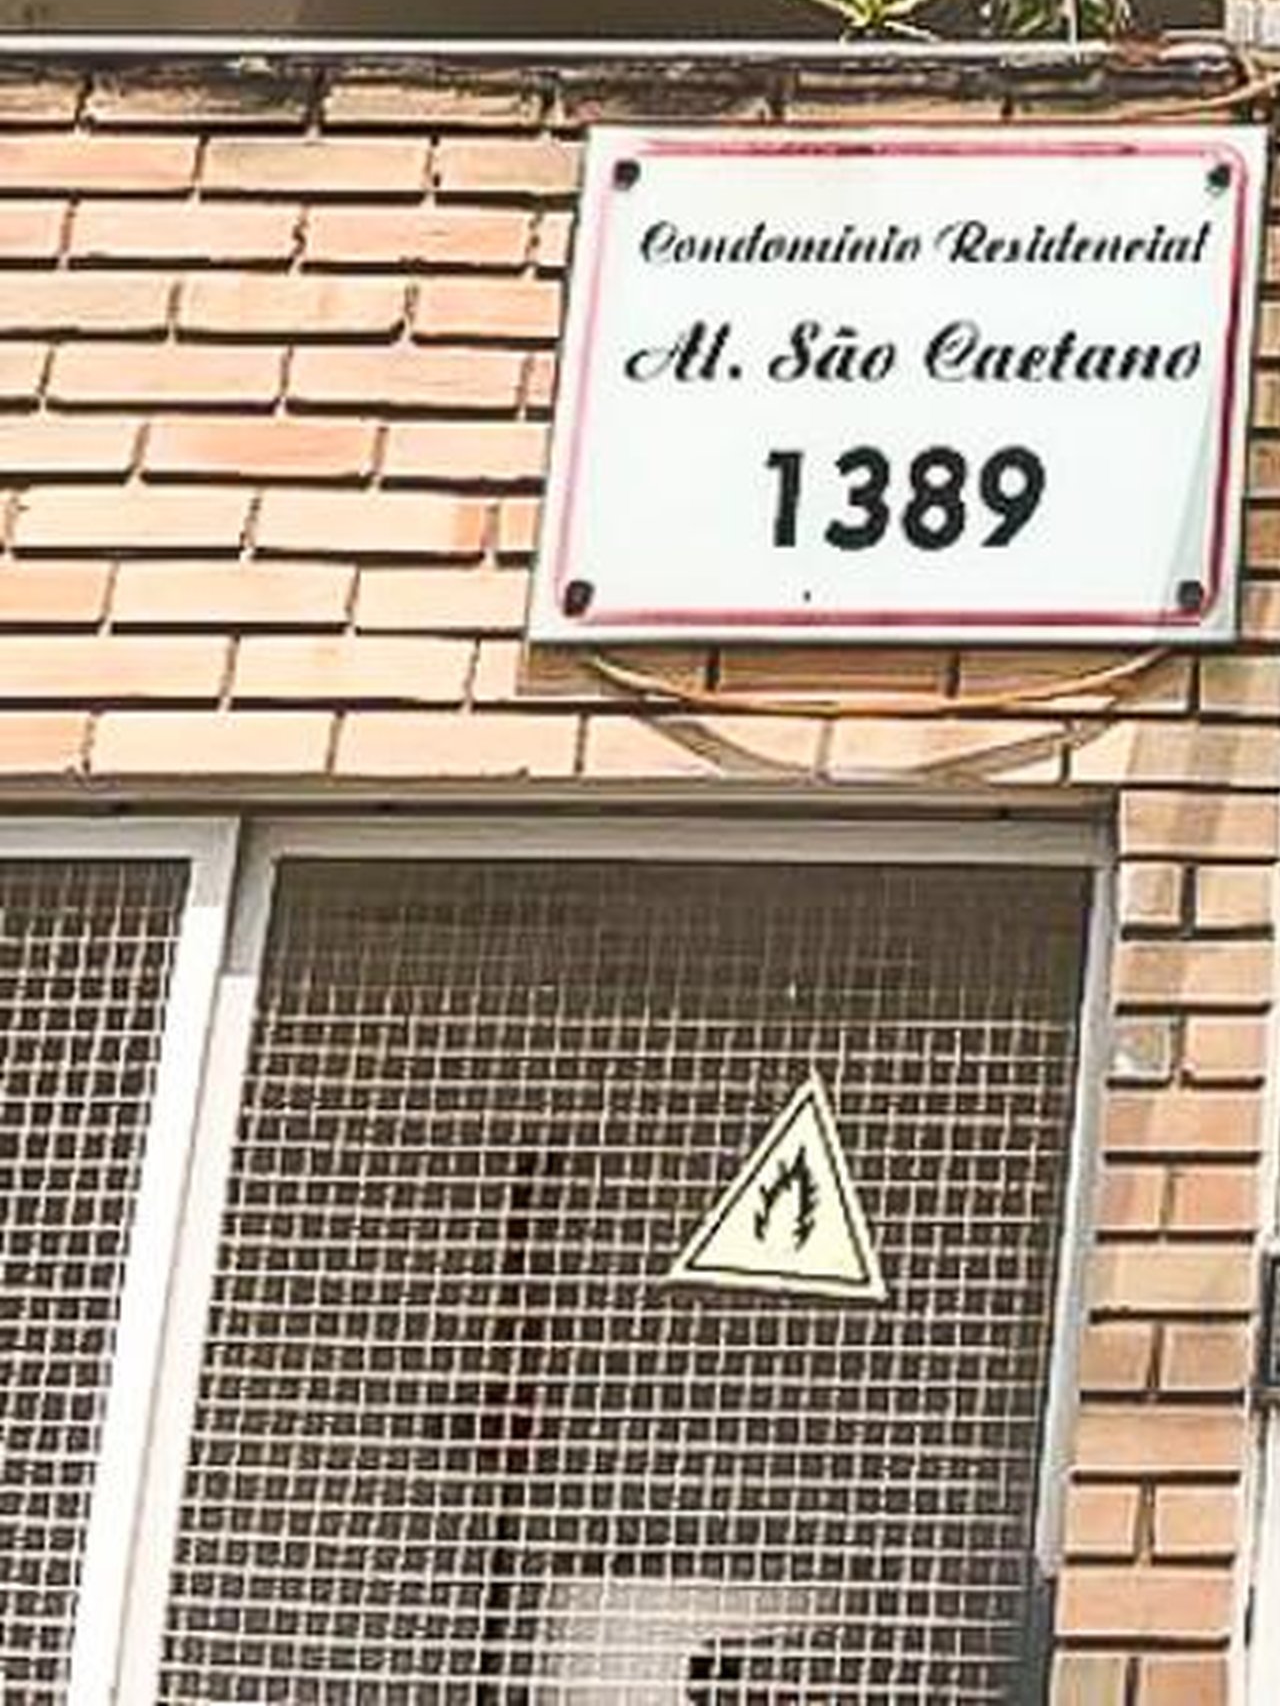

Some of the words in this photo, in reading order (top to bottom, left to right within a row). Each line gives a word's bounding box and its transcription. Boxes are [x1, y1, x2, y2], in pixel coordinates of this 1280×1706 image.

[640, 220, 921, 263] Condominio
[935, 220, 1212, 264] Residencial
[624, 321, 742, 382] Al.
[768, 321, 896, 383] São
[924, 321, 1201, 383] Caetano
[766, 446, 1046, 551] 1389
